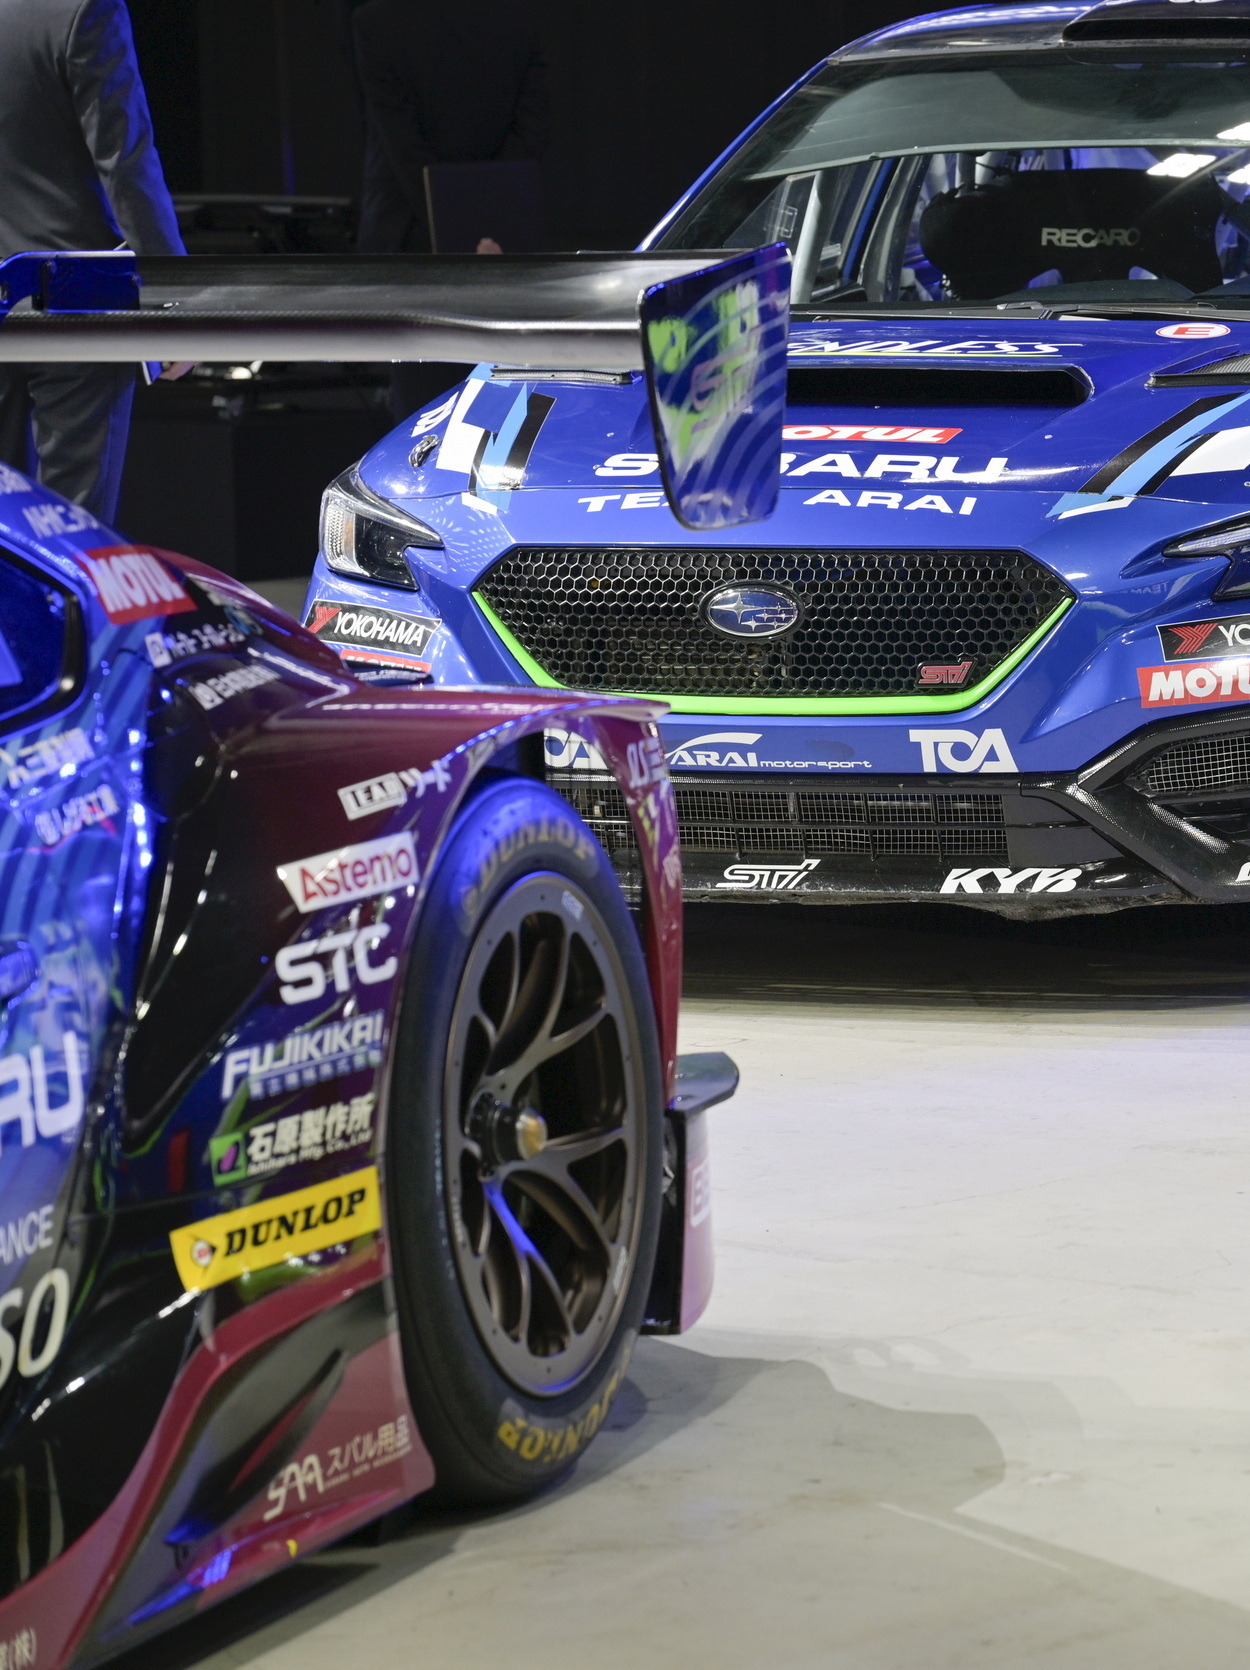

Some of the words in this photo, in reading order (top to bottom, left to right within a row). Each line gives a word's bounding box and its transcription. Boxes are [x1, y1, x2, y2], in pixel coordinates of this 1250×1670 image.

[1042, 227, 1140, 248] RECARO
[781, 426, 948, 442] OTUL
[595, 452, 1009, 483] SARU
[577, 493, 668, 513] TE
[803, 489, 976, 515] ARAI
[91, 553, 187, 614] MOTUL
[334, 612, 425, 647] YOKOHAMA
[668, 750, 758, 768] ARAI
[760, 759, 872, 769] motorsport
[909, 728, 1019, 772] TOA
[300, 849, 413, 903] Astemo
[939, 867, 1083, 893] KYB
[275, 921, 399, 1005] STC
[221, 1012, 383, 1099] FUJIKIKAI
[247, 1092, 376, 1163] 石原製作所
[224, 1188, 366, 1257] DUNLOP
